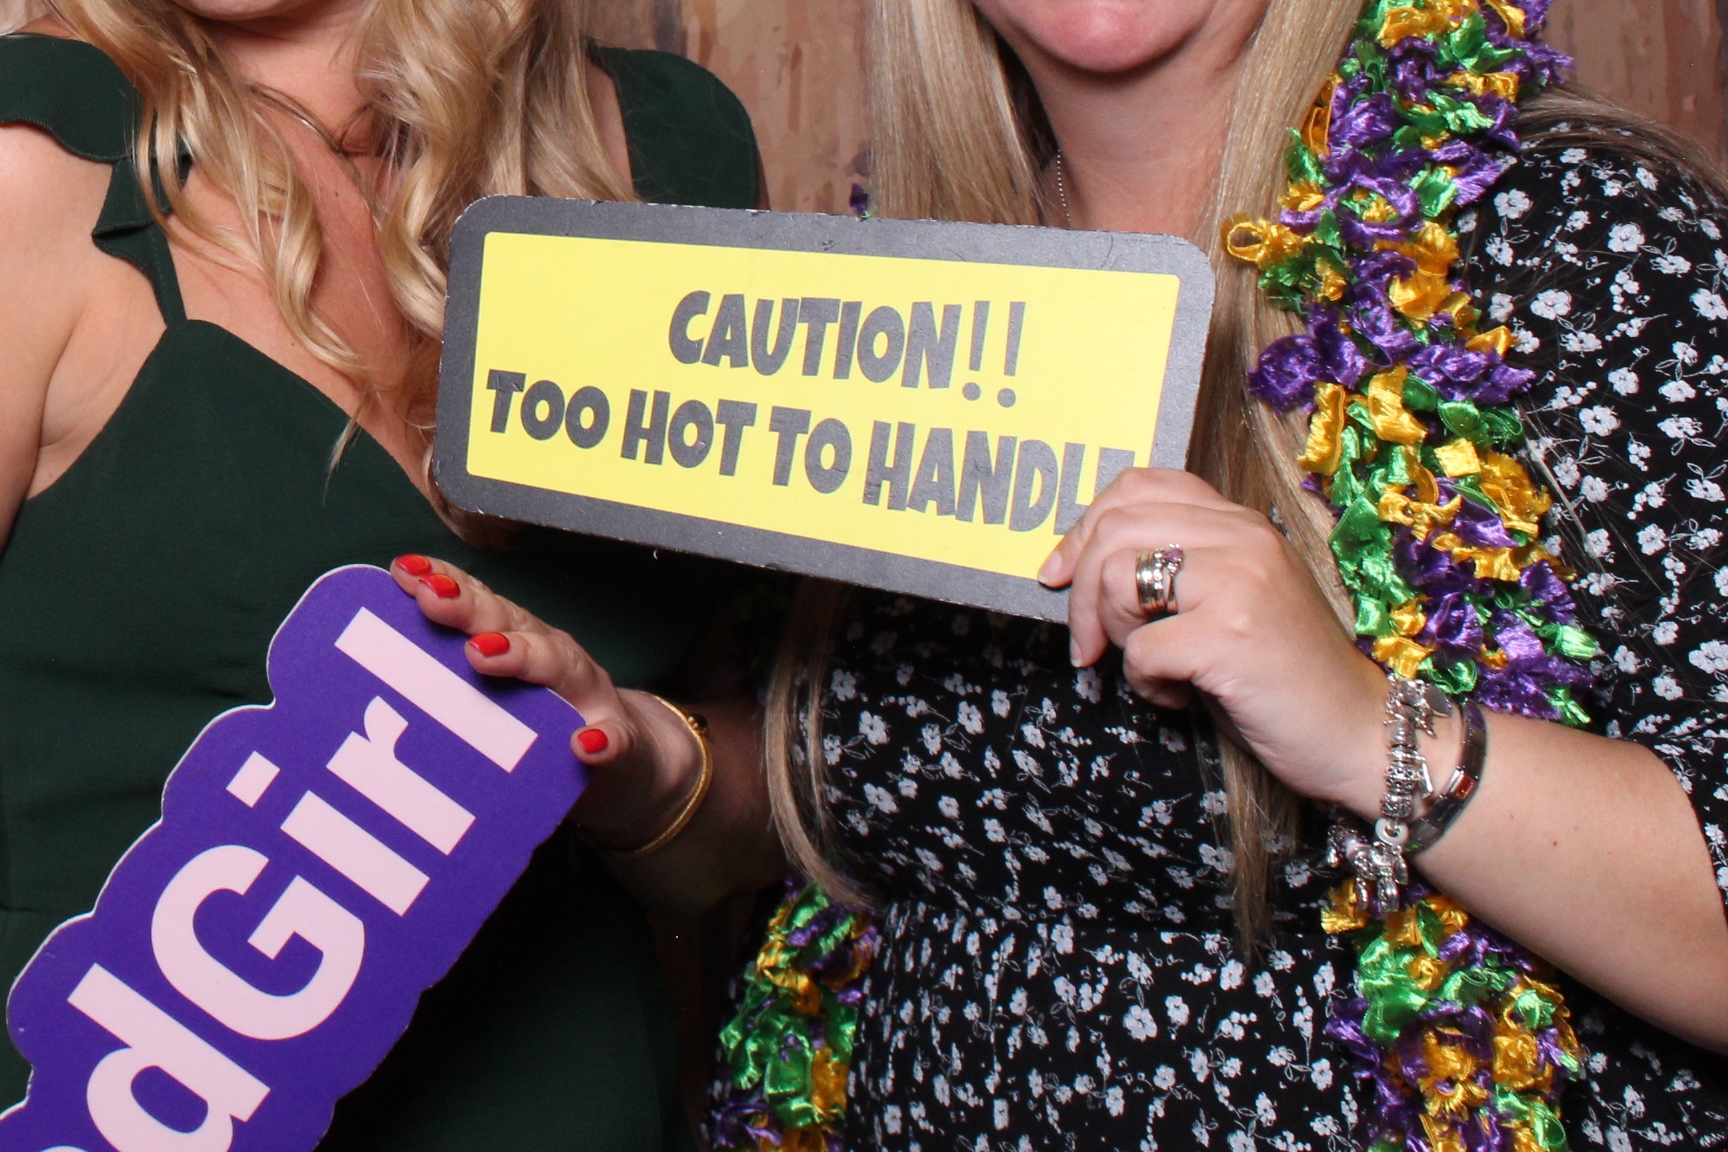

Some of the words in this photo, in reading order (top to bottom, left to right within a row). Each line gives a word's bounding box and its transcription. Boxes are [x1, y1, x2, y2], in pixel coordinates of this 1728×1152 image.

[668, 290, 1026, 408] CAUTION!!
[486, 369, 611, 450] TOO
[620, 388, 758, 478] HOT
[769, 406, 853, 495] TO
[38, 606, 539, 1152] dGirl
